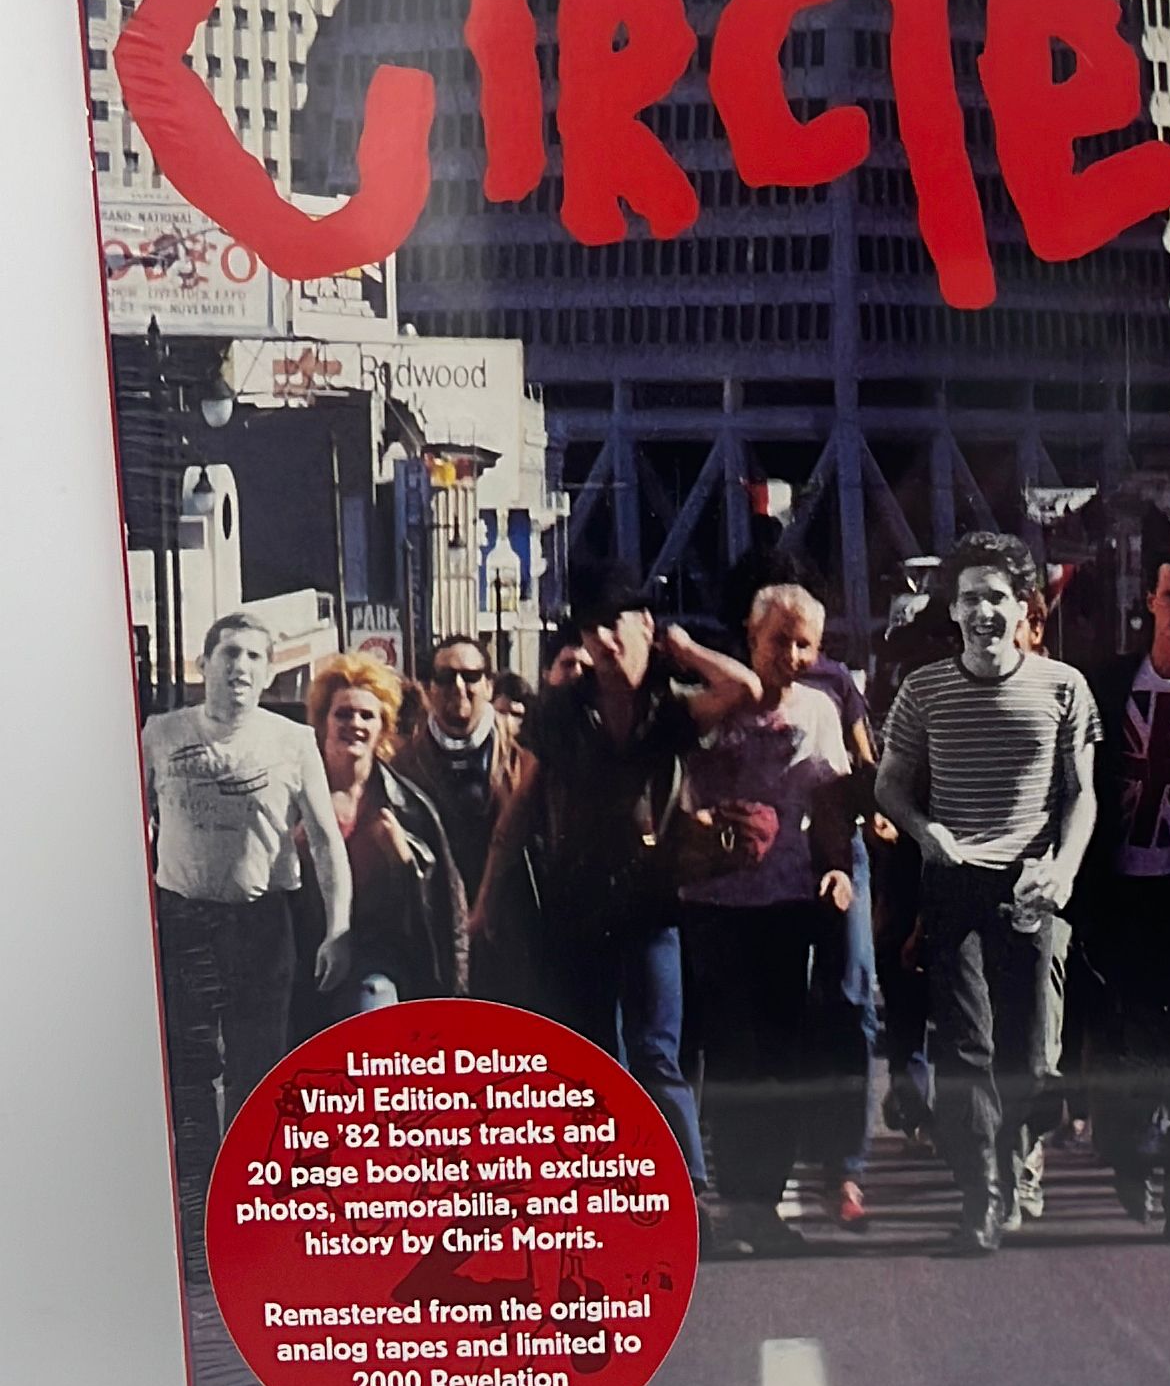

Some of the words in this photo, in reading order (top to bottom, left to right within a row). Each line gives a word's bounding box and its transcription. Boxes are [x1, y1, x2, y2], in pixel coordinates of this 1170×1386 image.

[138, 212, 192, 225] NATIONAL
[352, 604, 401, 631] PARK
[347, 1050, 446, 1077] Limited
[454, 1048, 548, 1074] Deluxe
[300, 1087, 365, 1115] Vinyl
[373, 1086, 477, 1112] Edition.
[486, 1083, 595, 1110] Includes
[284, 1124, 329, 1149] live
[337, 1123, 380, 1148] '82
[388, 1122, 472, 1148] bonus
[479, 1119, 556, 1145] tracks
[563, 1117, 616, 1143] and
[247, 1161, 282, 1186] 20
[290, 1165, 359, 1188] page
[366, 1157, 470, 1184] booklet
[476, 1155, 532, 1181] with
[540, 1153, 656, 1179] exclusive
[236, 1196, 336, 1225] photos,
[344, 1191, 518, 1220] memorabilia,
[526, 1189, 578, 1215] and
[586, 1188, 670, 1214] album
[305, 1231, 394, 1256] history
[401, 1229, 435, 1255] by
[442, 1227, 504, 1253] Chris
[512, 1225, 604, 1251] Morris.
[264, 1299, 422, 1327] Remastered
[428, 1298, 493, 1323] from
[500, 1297, 543, 1322] the
[550, 1293, 651, 1322] original
[276, 1336, 368, 1363] analog
[375, 1338, 448, 1362] tapes
[456, 1332, 508, 1358] and
[516, 1329, 606, 1356] limited
[613, 1332, 642, 1354] to
